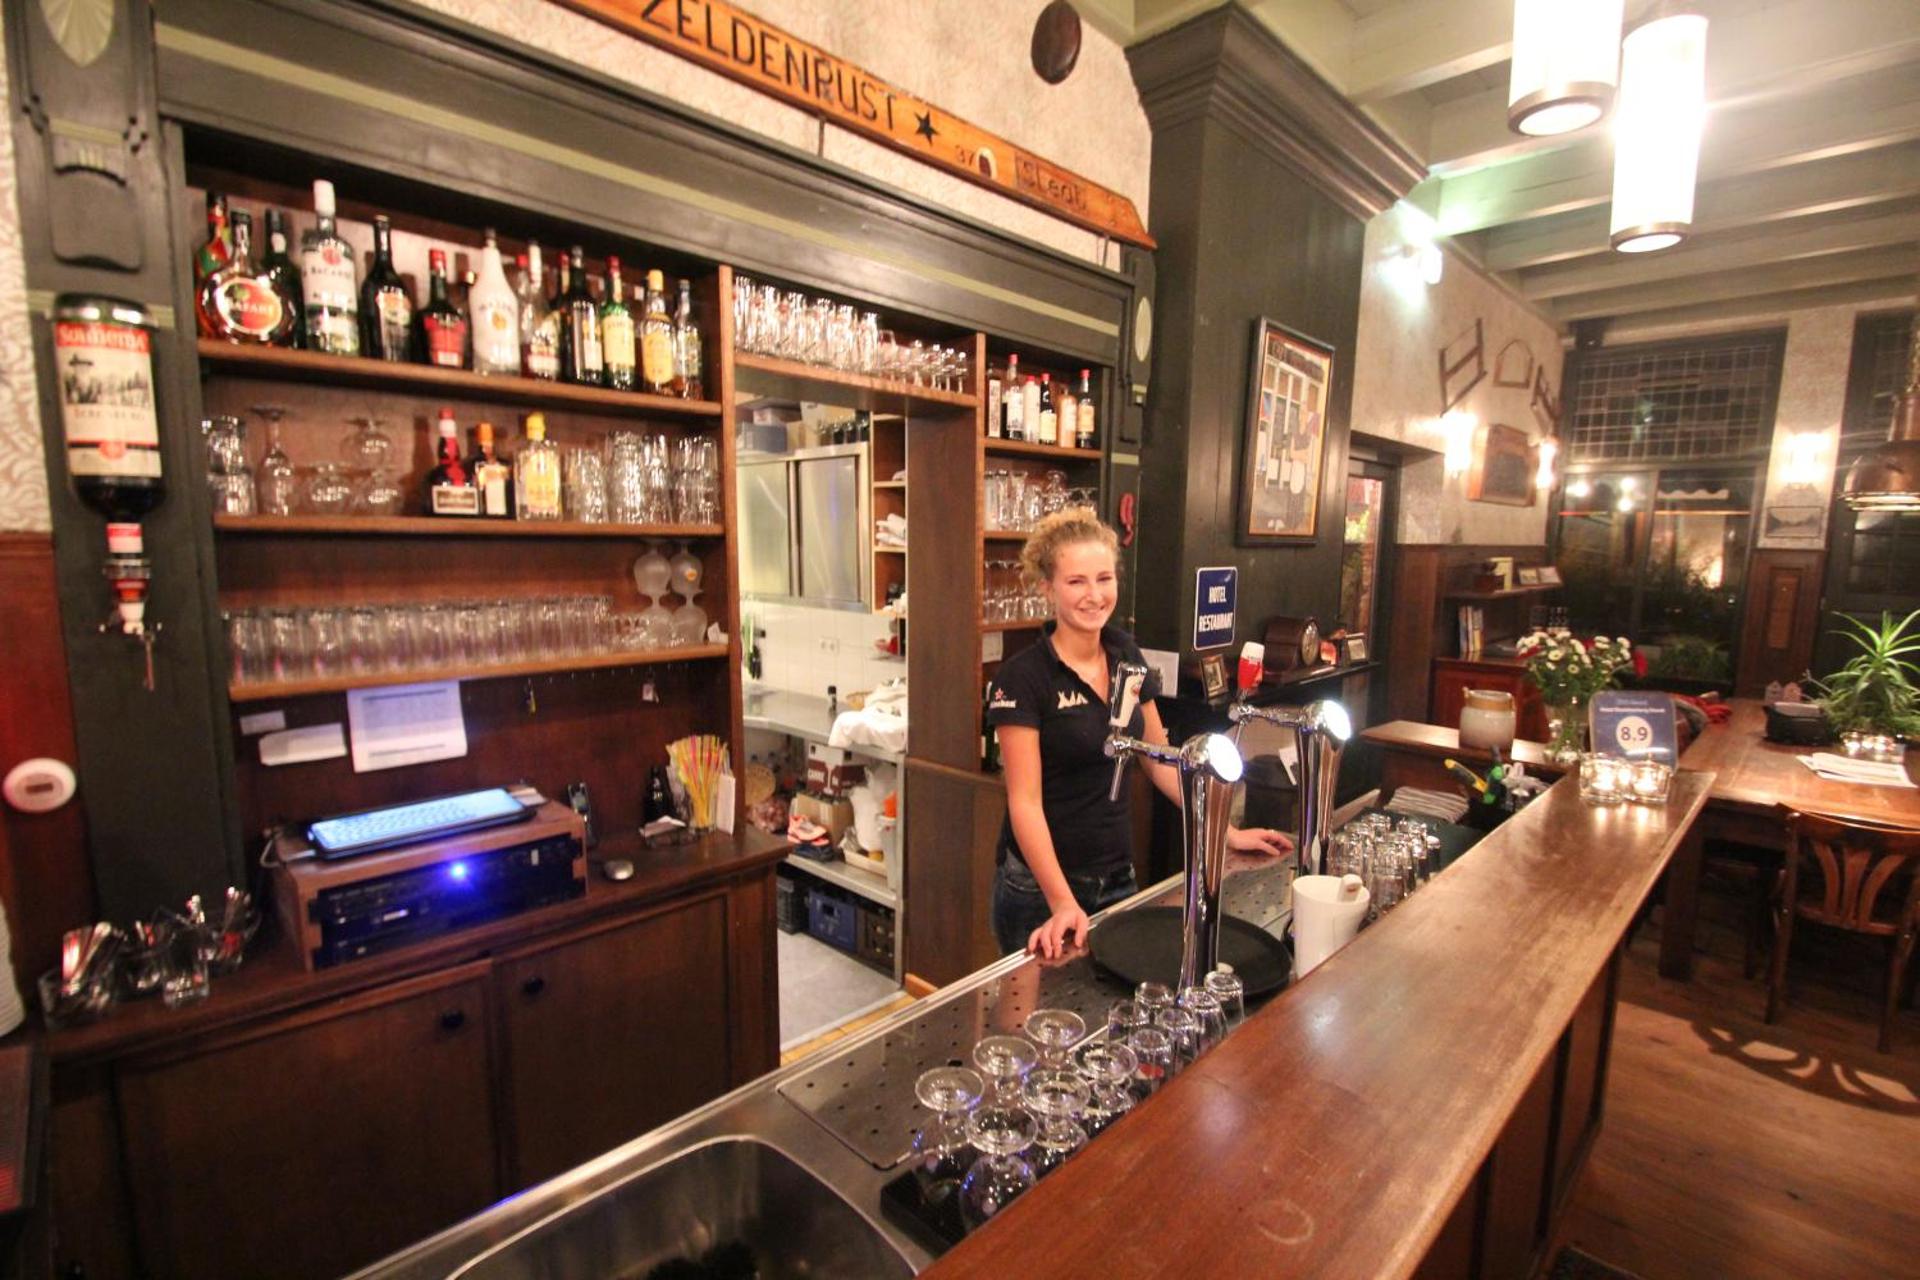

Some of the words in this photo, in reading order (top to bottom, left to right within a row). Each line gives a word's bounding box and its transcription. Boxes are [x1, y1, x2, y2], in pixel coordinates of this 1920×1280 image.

[640, 0, 897, 130] ZELDENRUST
[1198, 612, 1234, 632] RESTAURANT
[1620, 726, 1649, 742] 8.9
